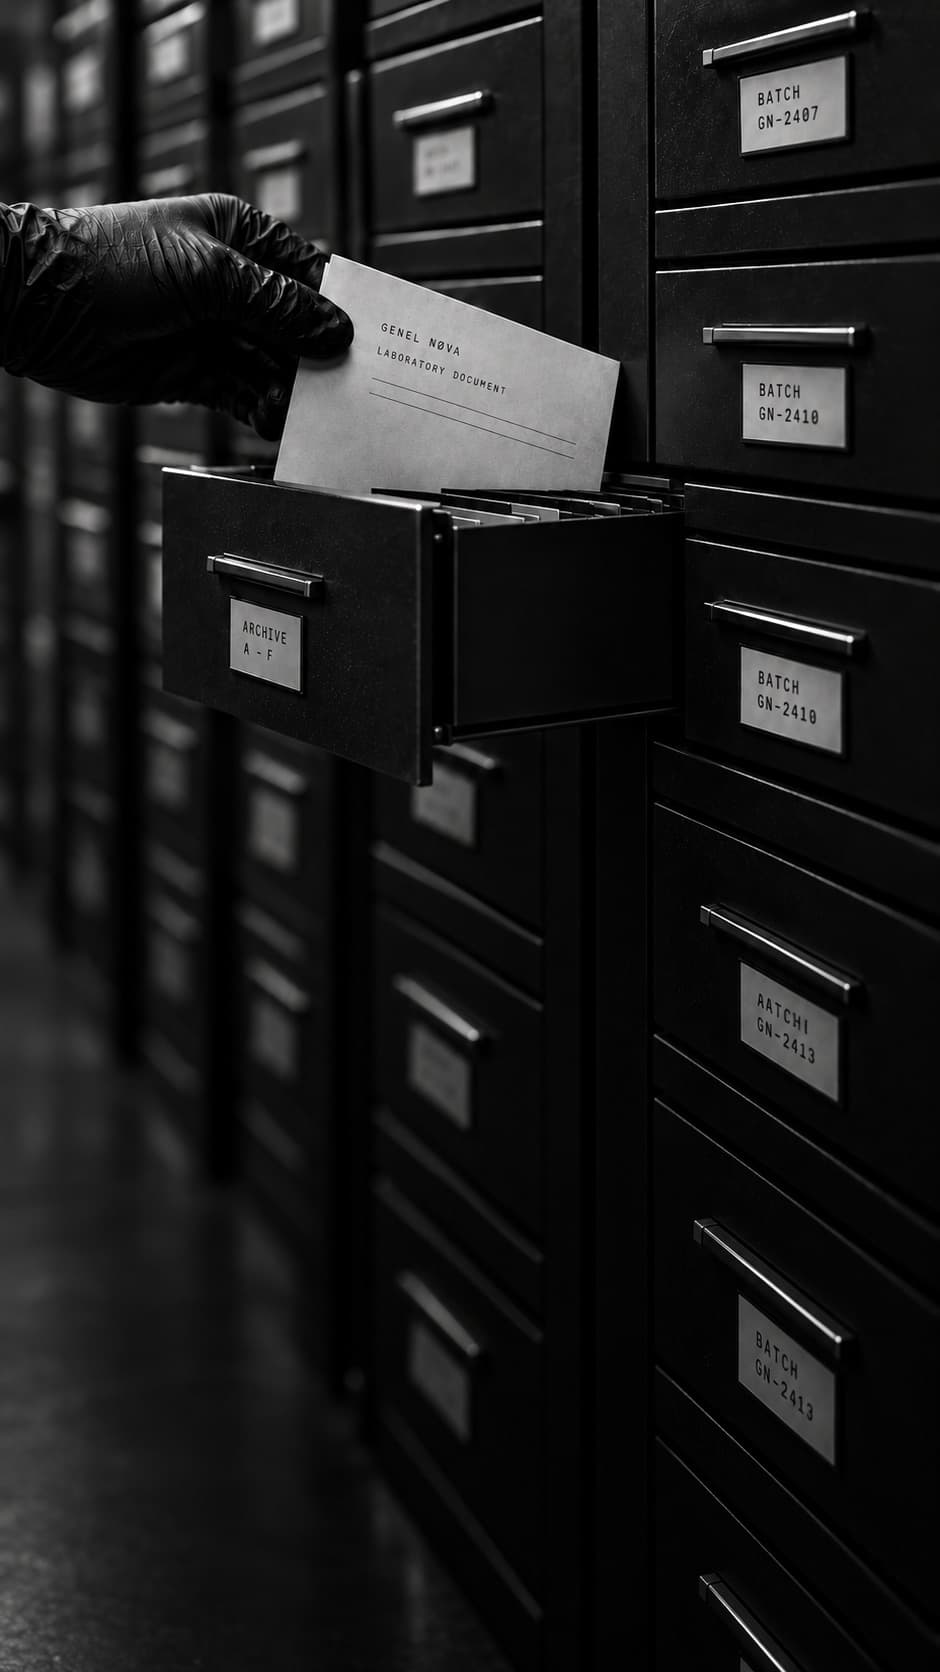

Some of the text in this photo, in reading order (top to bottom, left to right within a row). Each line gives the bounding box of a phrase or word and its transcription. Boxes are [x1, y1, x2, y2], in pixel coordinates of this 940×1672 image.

[758, 84, 800, 106] BATCH
[758, 105, 818, 130] GN-2407
[381, 322, 420, 344] GENEL
[377, 346, 507, 395] LABORATORY DOCUMENT
[759, 382, 801, 399] BATCH
[759, 406, 819, 425] GN-2410
[242, 620, 287, 645] ARCHIVE
[243, 642, 250, 655] A
[267, 648, 273, 661] F
[758, 670, 799, 695] BATCH
[757, 694, 817, 725] GN-2410
[757, 1017, 815, 1064] GN-2413
[756, 1330, 798, 1380] BATCH
[755, 1358, 814, 1422] GN-2413
